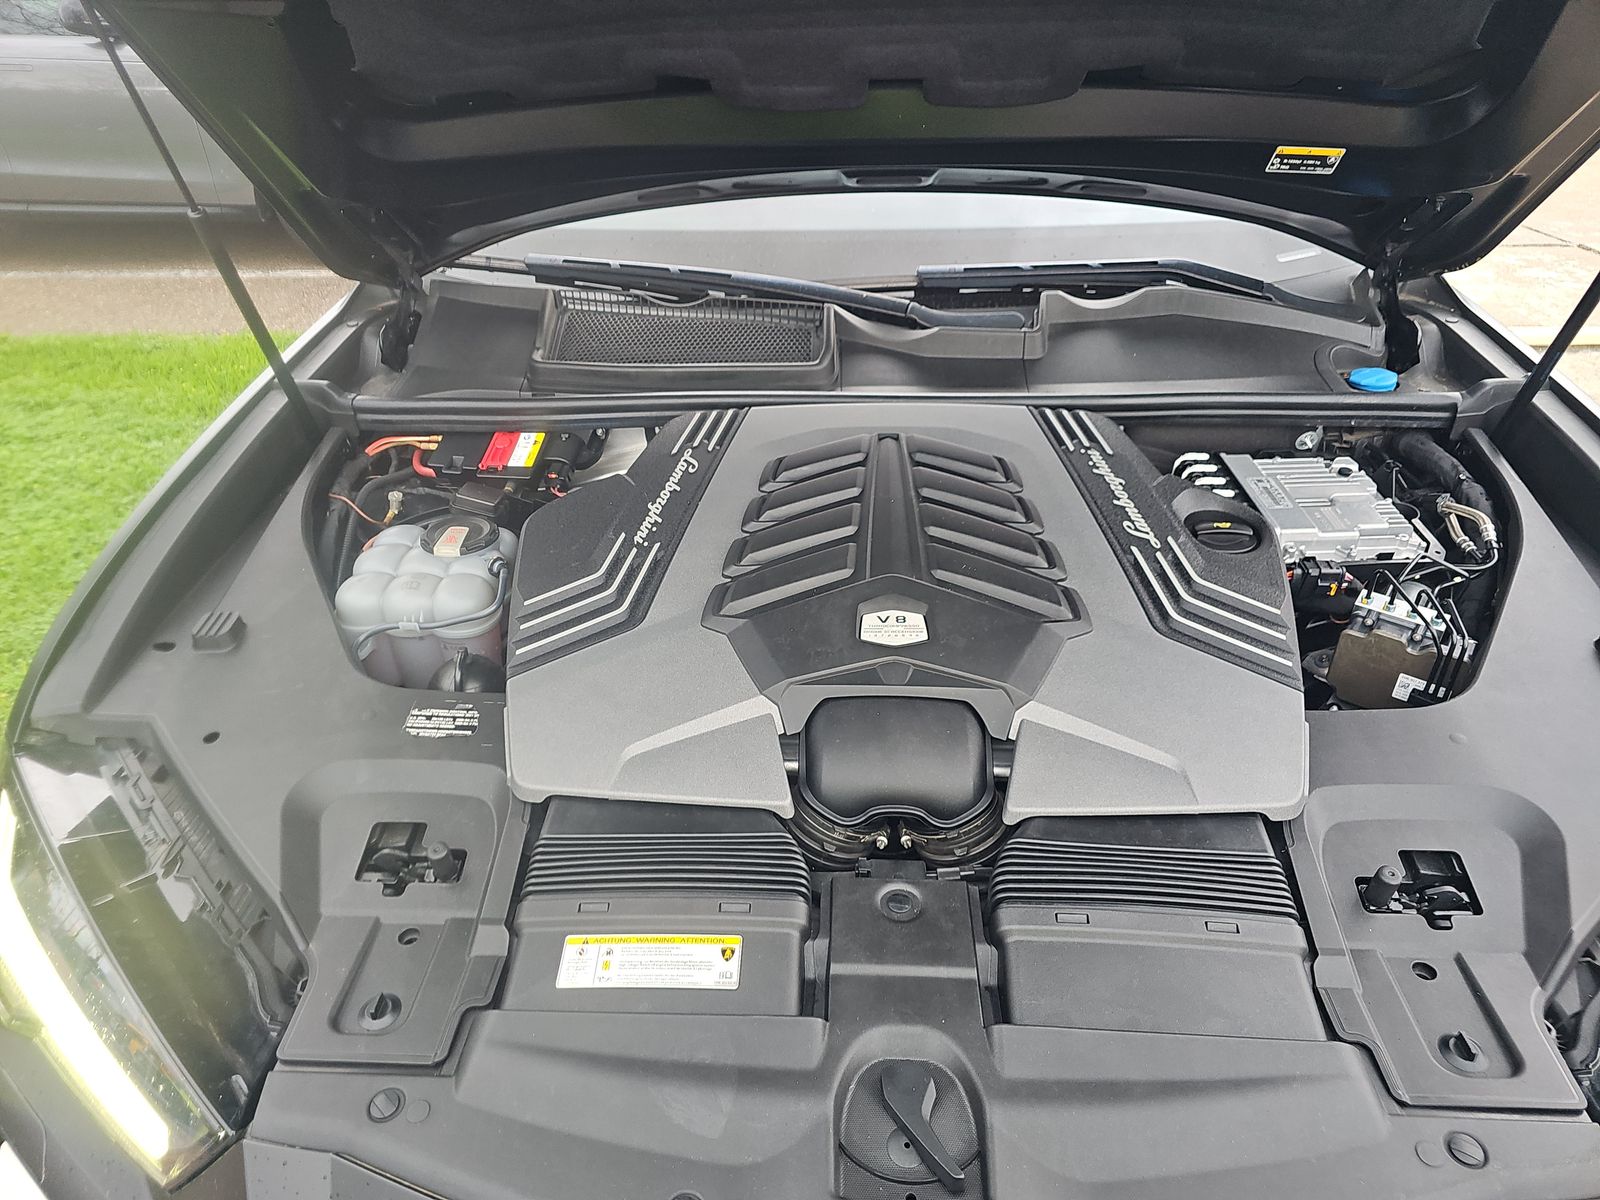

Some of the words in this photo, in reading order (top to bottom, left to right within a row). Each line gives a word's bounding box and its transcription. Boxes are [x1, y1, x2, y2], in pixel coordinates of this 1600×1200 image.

[634, 448, 698, 546] Lamborghini
[1080, 448, 1161, 549] Lamborghini
[877, 615, 906, 623] V8
